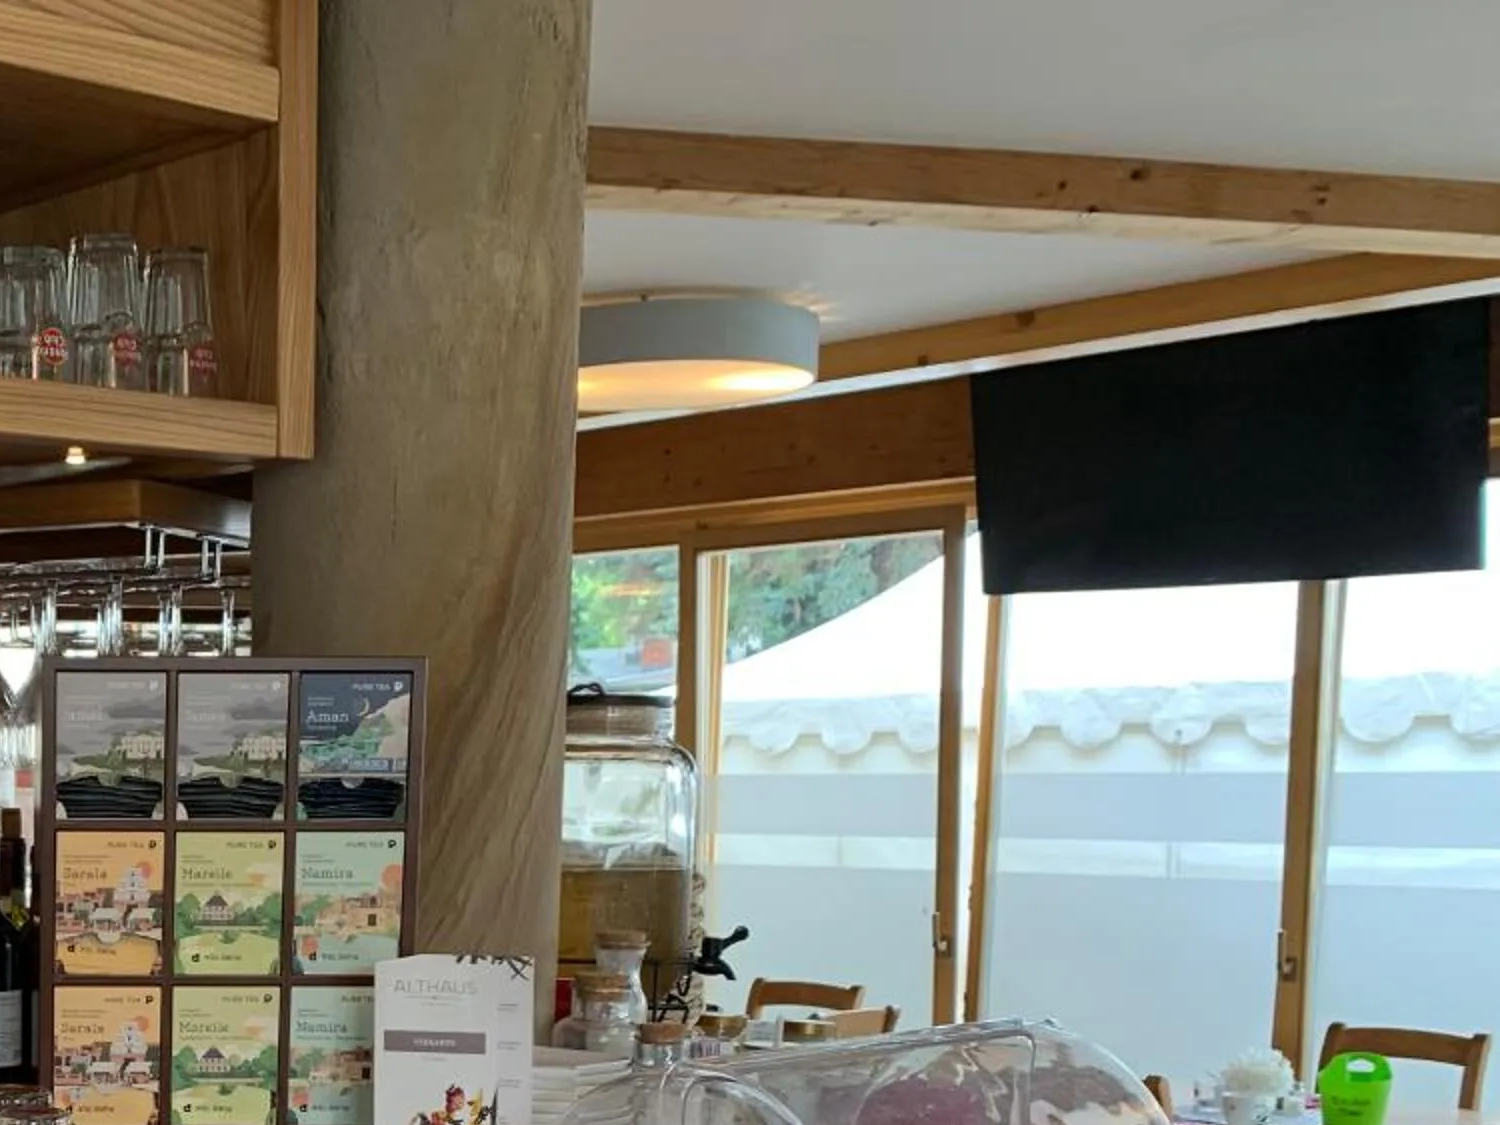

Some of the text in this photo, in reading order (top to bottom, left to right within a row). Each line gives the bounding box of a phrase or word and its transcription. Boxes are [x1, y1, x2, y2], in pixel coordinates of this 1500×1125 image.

[307, 709, 350, 722] Aman
[301, 866, 354, 880] Namira
[394, 978, 478, 995] ALTHAUS
[295, 1020, 348, 1034] Namira
